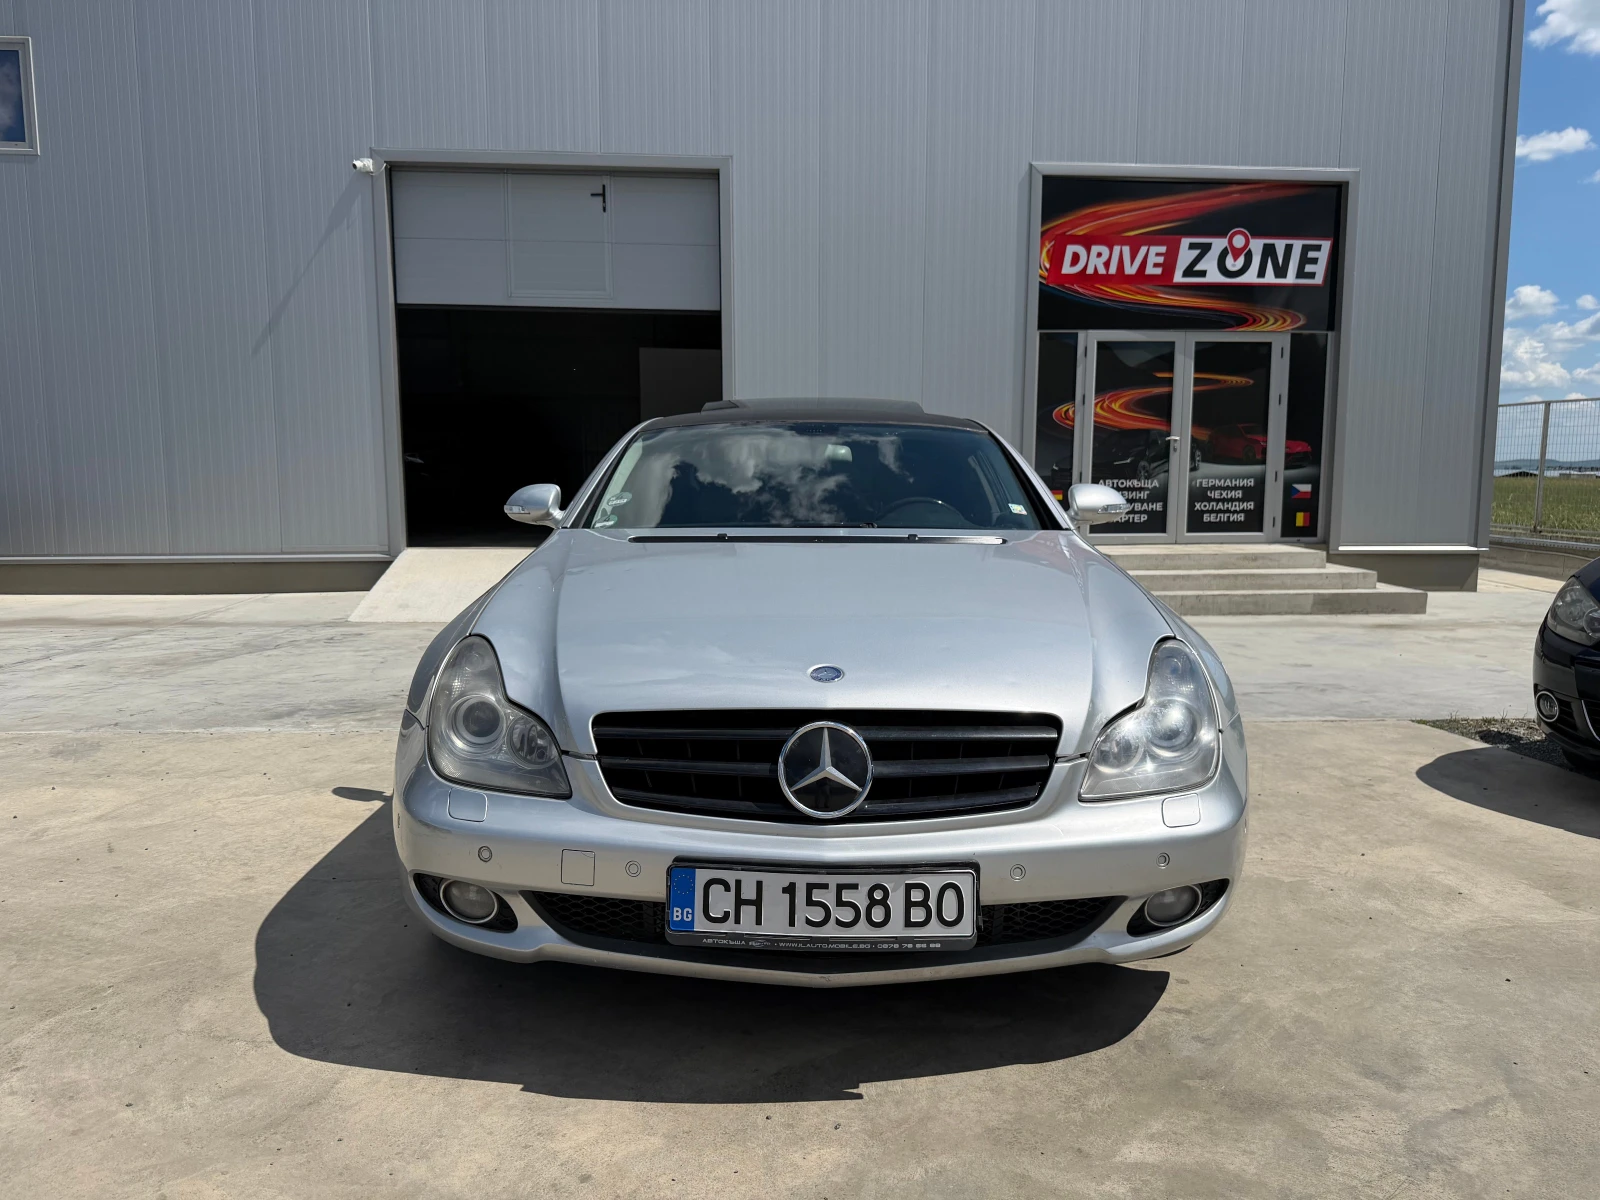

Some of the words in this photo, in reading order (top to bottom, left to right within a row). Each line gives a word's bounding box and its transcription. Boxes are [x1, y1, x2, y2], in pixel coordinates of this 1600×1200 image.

[1061, 244, 1167, 275] DRIVE
[1182, 241, 1323, 279] ZONE
[1098, 479, 1159, 489] АВТОКЪЩА
[1196, 478, 1254, 487] ГЕРМАНИЯ
[1119, 490, 1150, 500] ЗИНГ
[1207, 490, 1242, 499] ЧЕХИЯ
[1129, 502, 1163, 511] УВАНЕ
[1194, 501, 1254, 512] ХОЛАНДИЯ
[1114, 514, 1148, 523] АРТЕР
[1203, 513, 1245, 522] БЕЛГИЯ
[702, 878, 763, 926] CH
[782, 881, 892, 928] 1558
[904, 880, 965, 928] BO
[673, 907, 693, 922] BG
